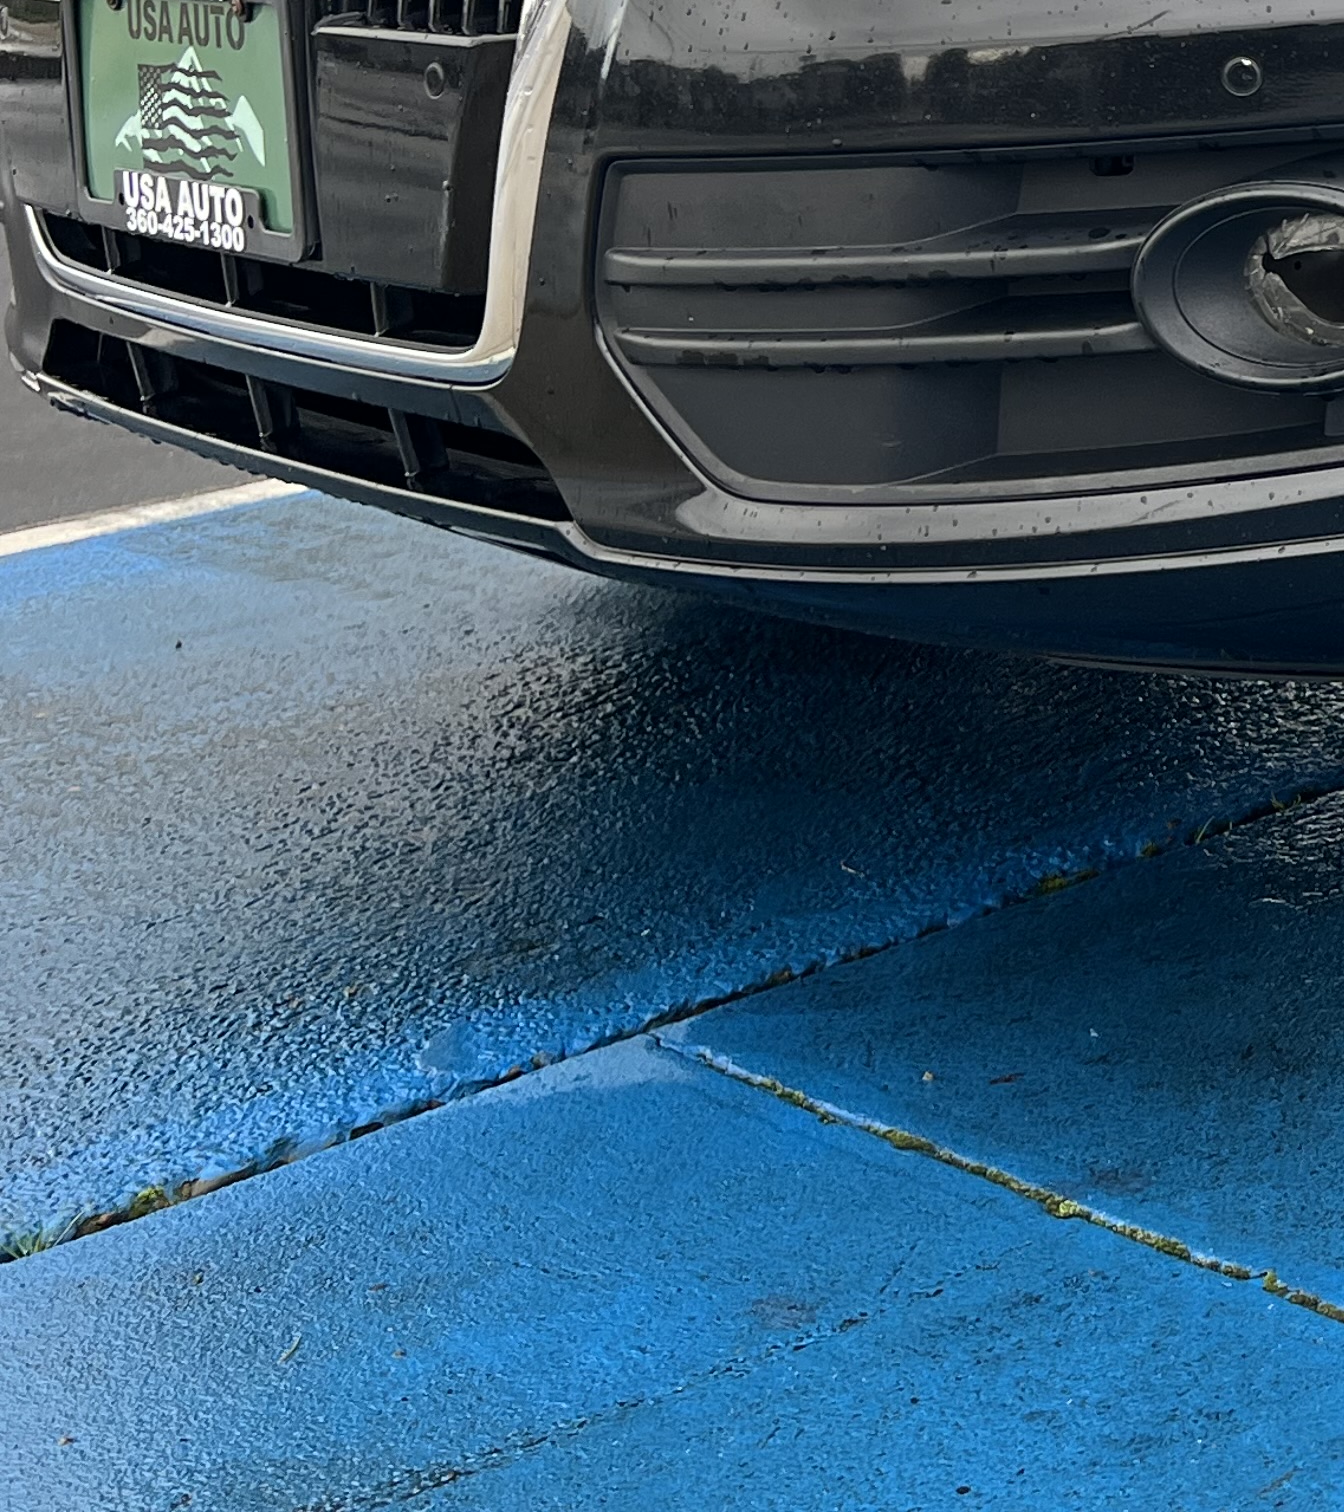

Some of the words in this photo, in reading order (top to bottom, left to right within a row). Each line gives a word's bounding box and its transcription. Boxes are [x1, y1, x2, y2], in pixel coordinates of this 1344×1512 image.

[177, 1, 245, 51] AUTO
[122, 170, 173, 215] USA
[176, 179, 244, 227] AUTO
[125, 206, 246, 253] 360-425-1300
